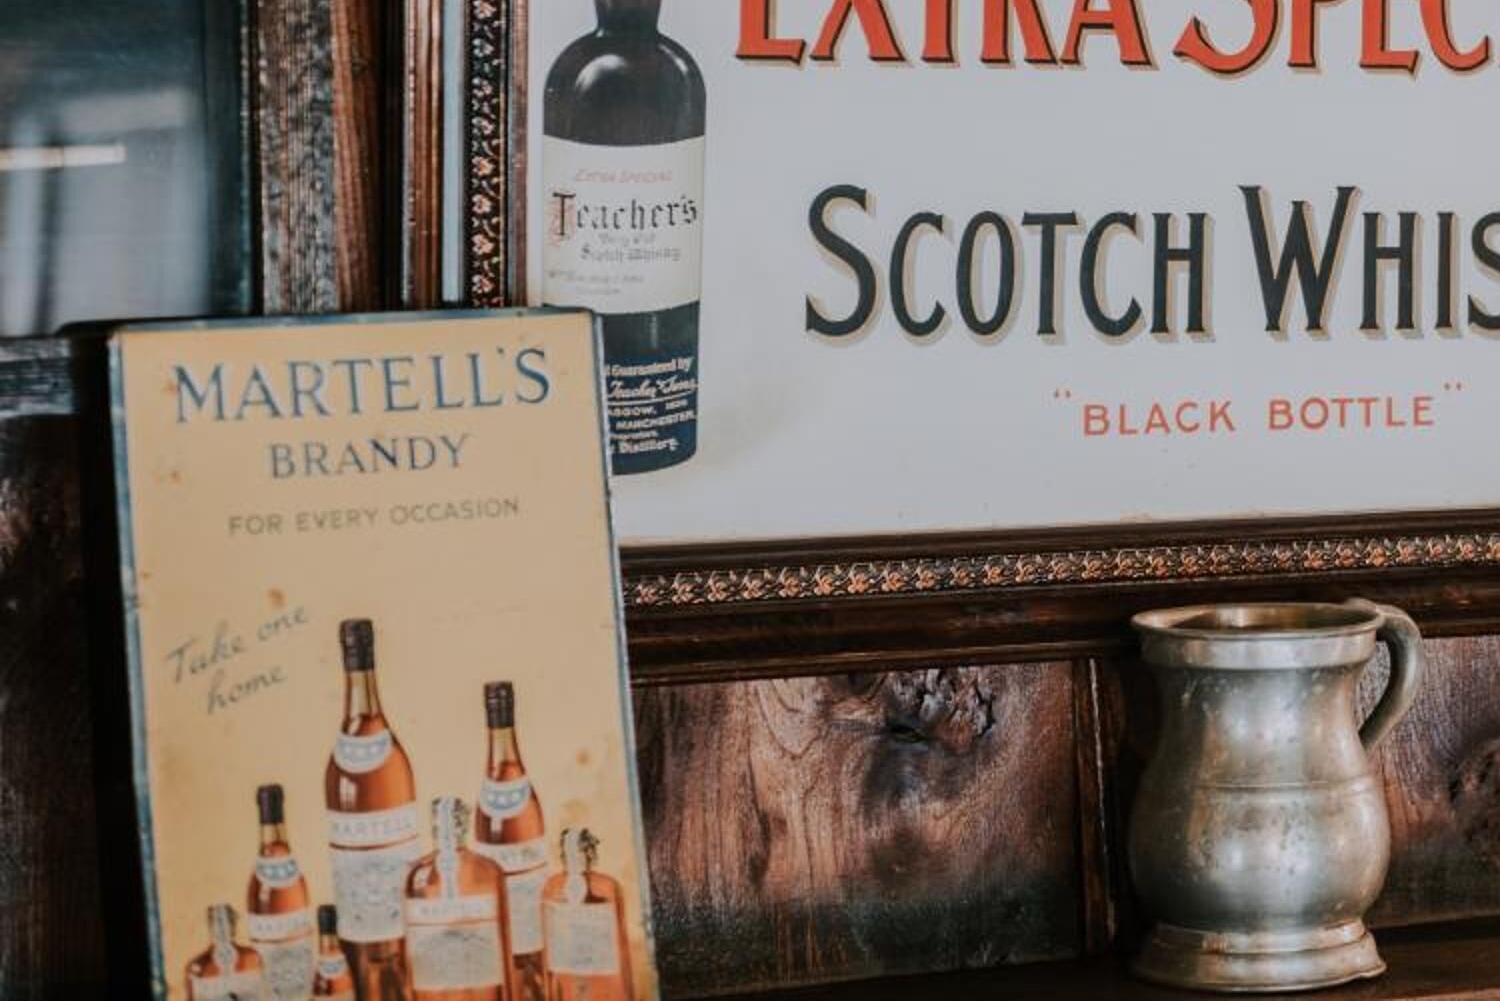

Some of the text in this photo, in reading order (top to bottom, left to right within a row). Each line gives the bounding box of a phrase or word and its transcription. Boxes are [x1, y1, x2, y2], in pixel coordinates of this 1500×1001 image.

[551, 191, 698, 237] Teacher's
[805, 184, 1215, 342] SCOTCH
[172, 347, 551, 424] MARTELL'S
[269, 432, 470, 479] BRANDY
[228, 496, 520, 537] FOR EVERY OCCASION
[165, 606, 309, 684] Take one
[207, 667, 288, 716] home
